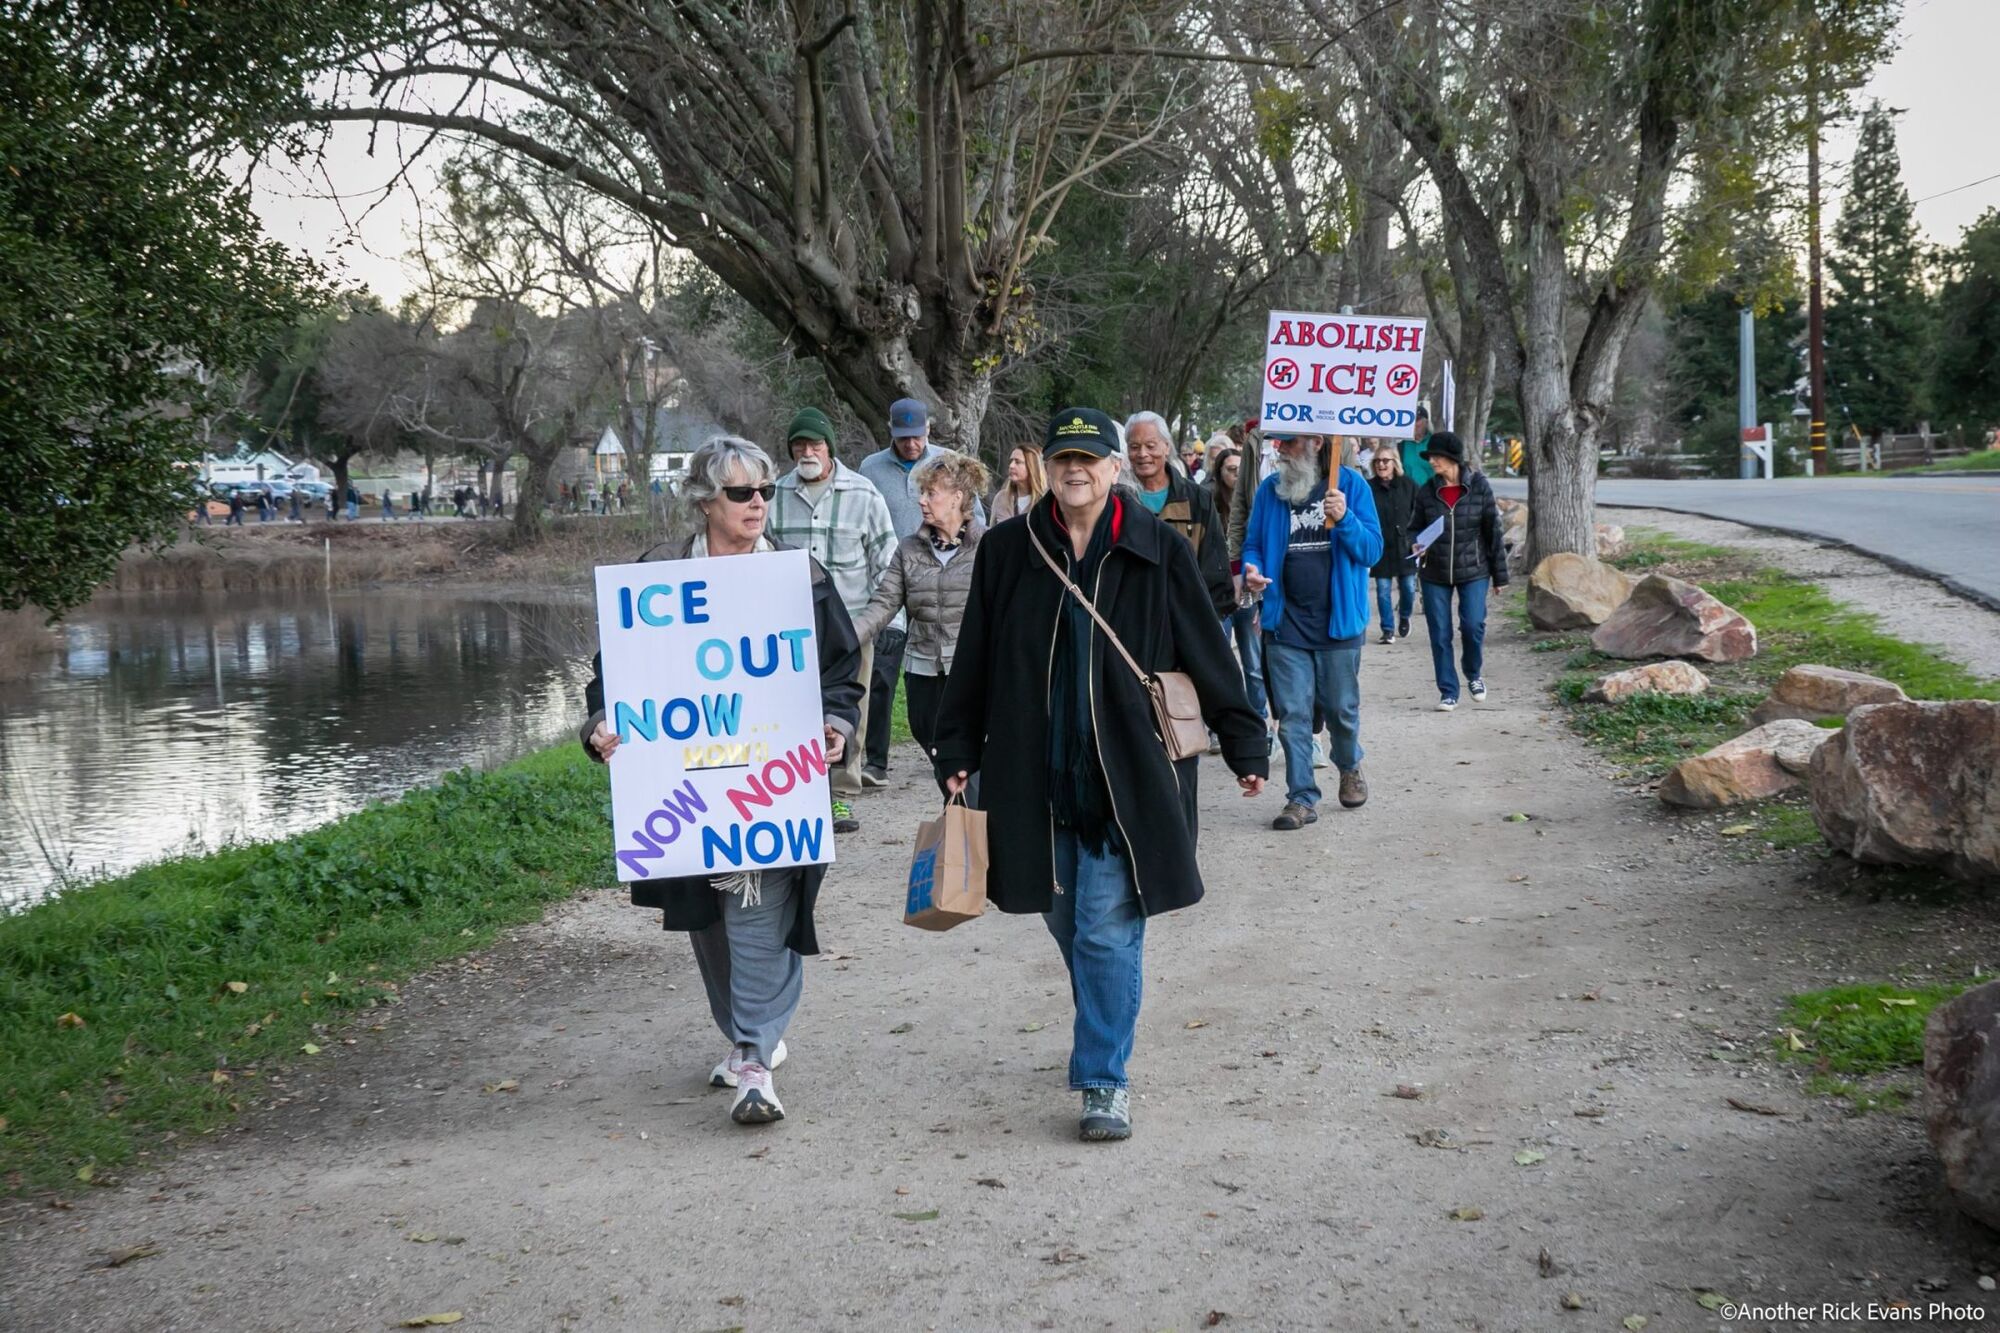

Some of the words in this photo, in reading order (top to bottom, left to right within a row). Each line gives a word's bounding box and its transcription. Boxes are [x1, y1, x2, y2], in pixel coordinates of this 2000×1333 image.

[1270, 320, 1423, 352] ABOLISH
[1308, 363, 1378, 397] ICE
[1264, 402, 1314, 423] FOR
[1338, 406, 1416, 428] GOOD
[617, 580, 710, 629] ICE
[695, 628, 812, 681] OUT
[726, 738, 827, 822] NOW
[615, 779, 708, 878] NOW
[701, 817, 824, 869] NOW
